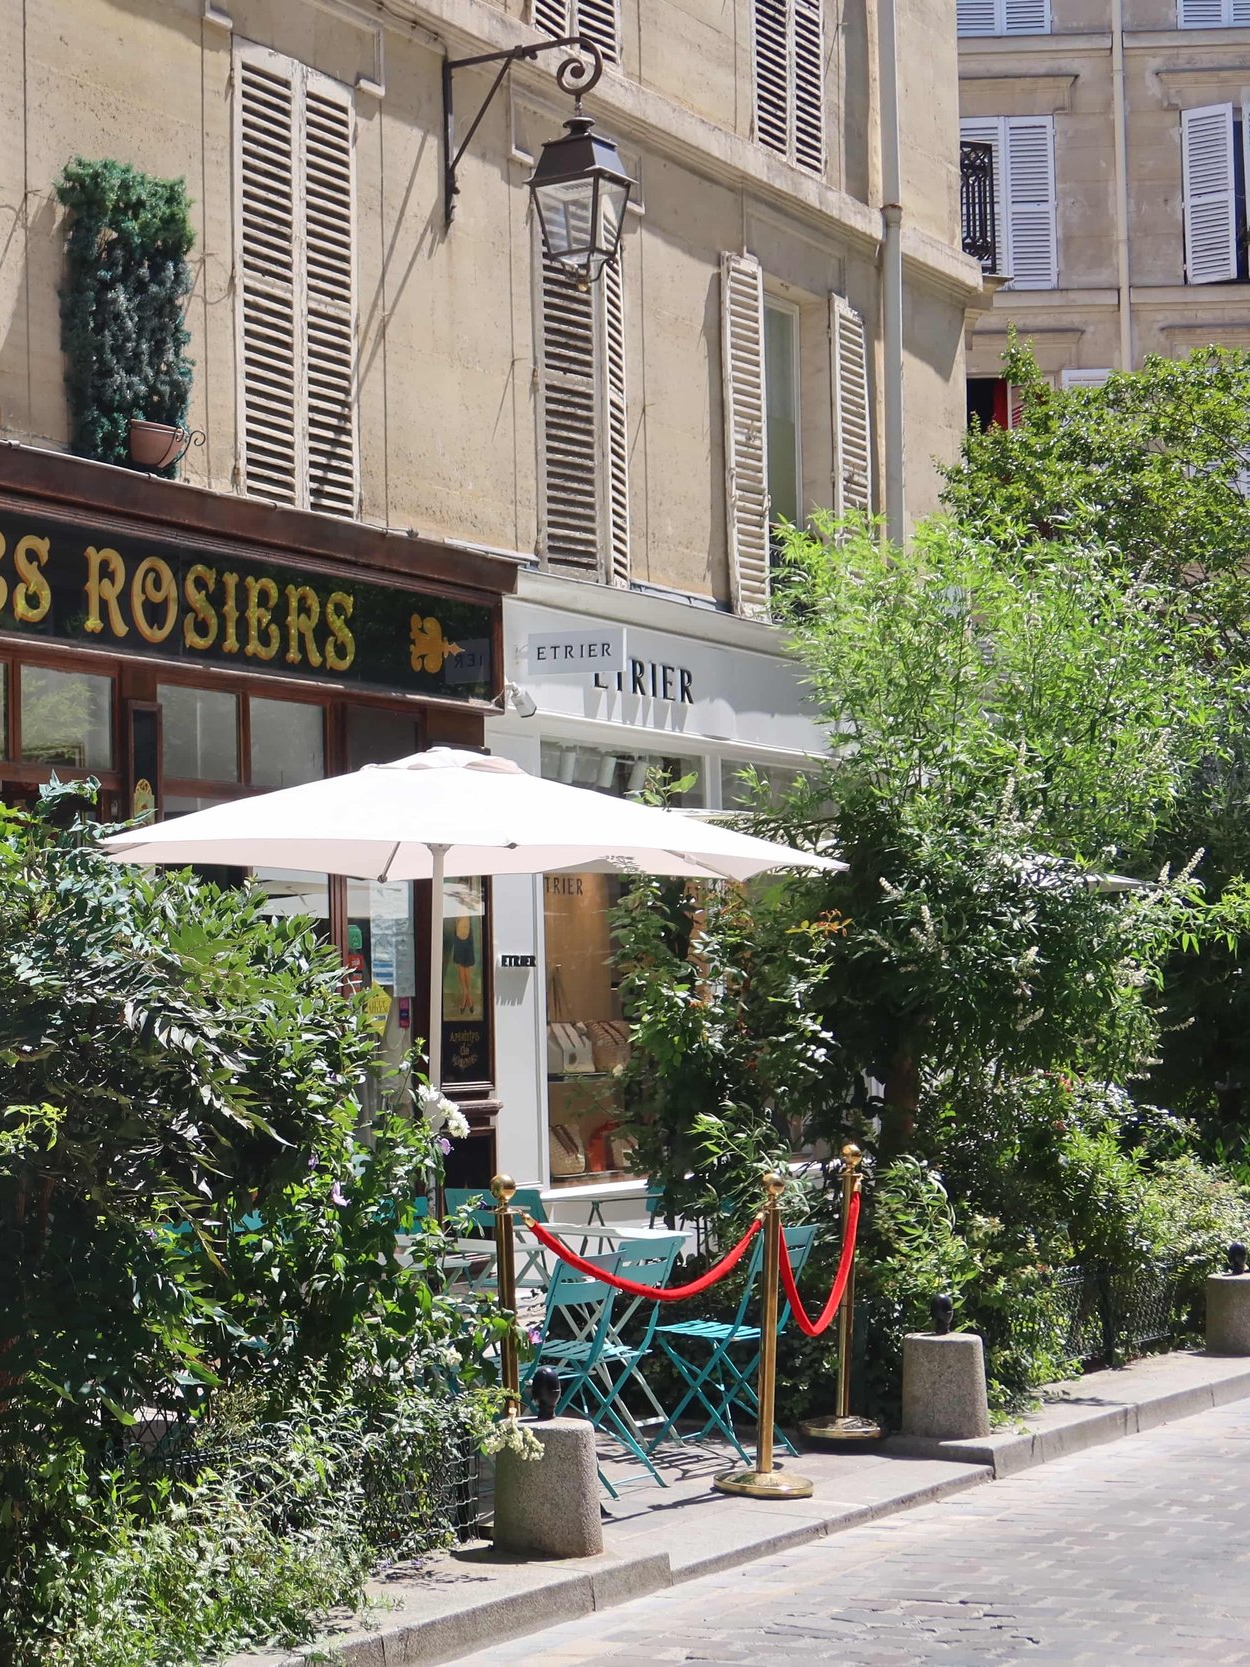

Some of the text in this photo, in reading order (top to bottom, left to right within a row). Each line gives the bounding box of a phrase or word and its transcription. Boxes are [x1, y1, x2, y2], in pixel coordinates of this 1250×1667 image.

[83, 545, 356, 671] ROSIERS
[537, 643, 612, 661] ETRIER
[501, 954, 536, 968] ETRIER
